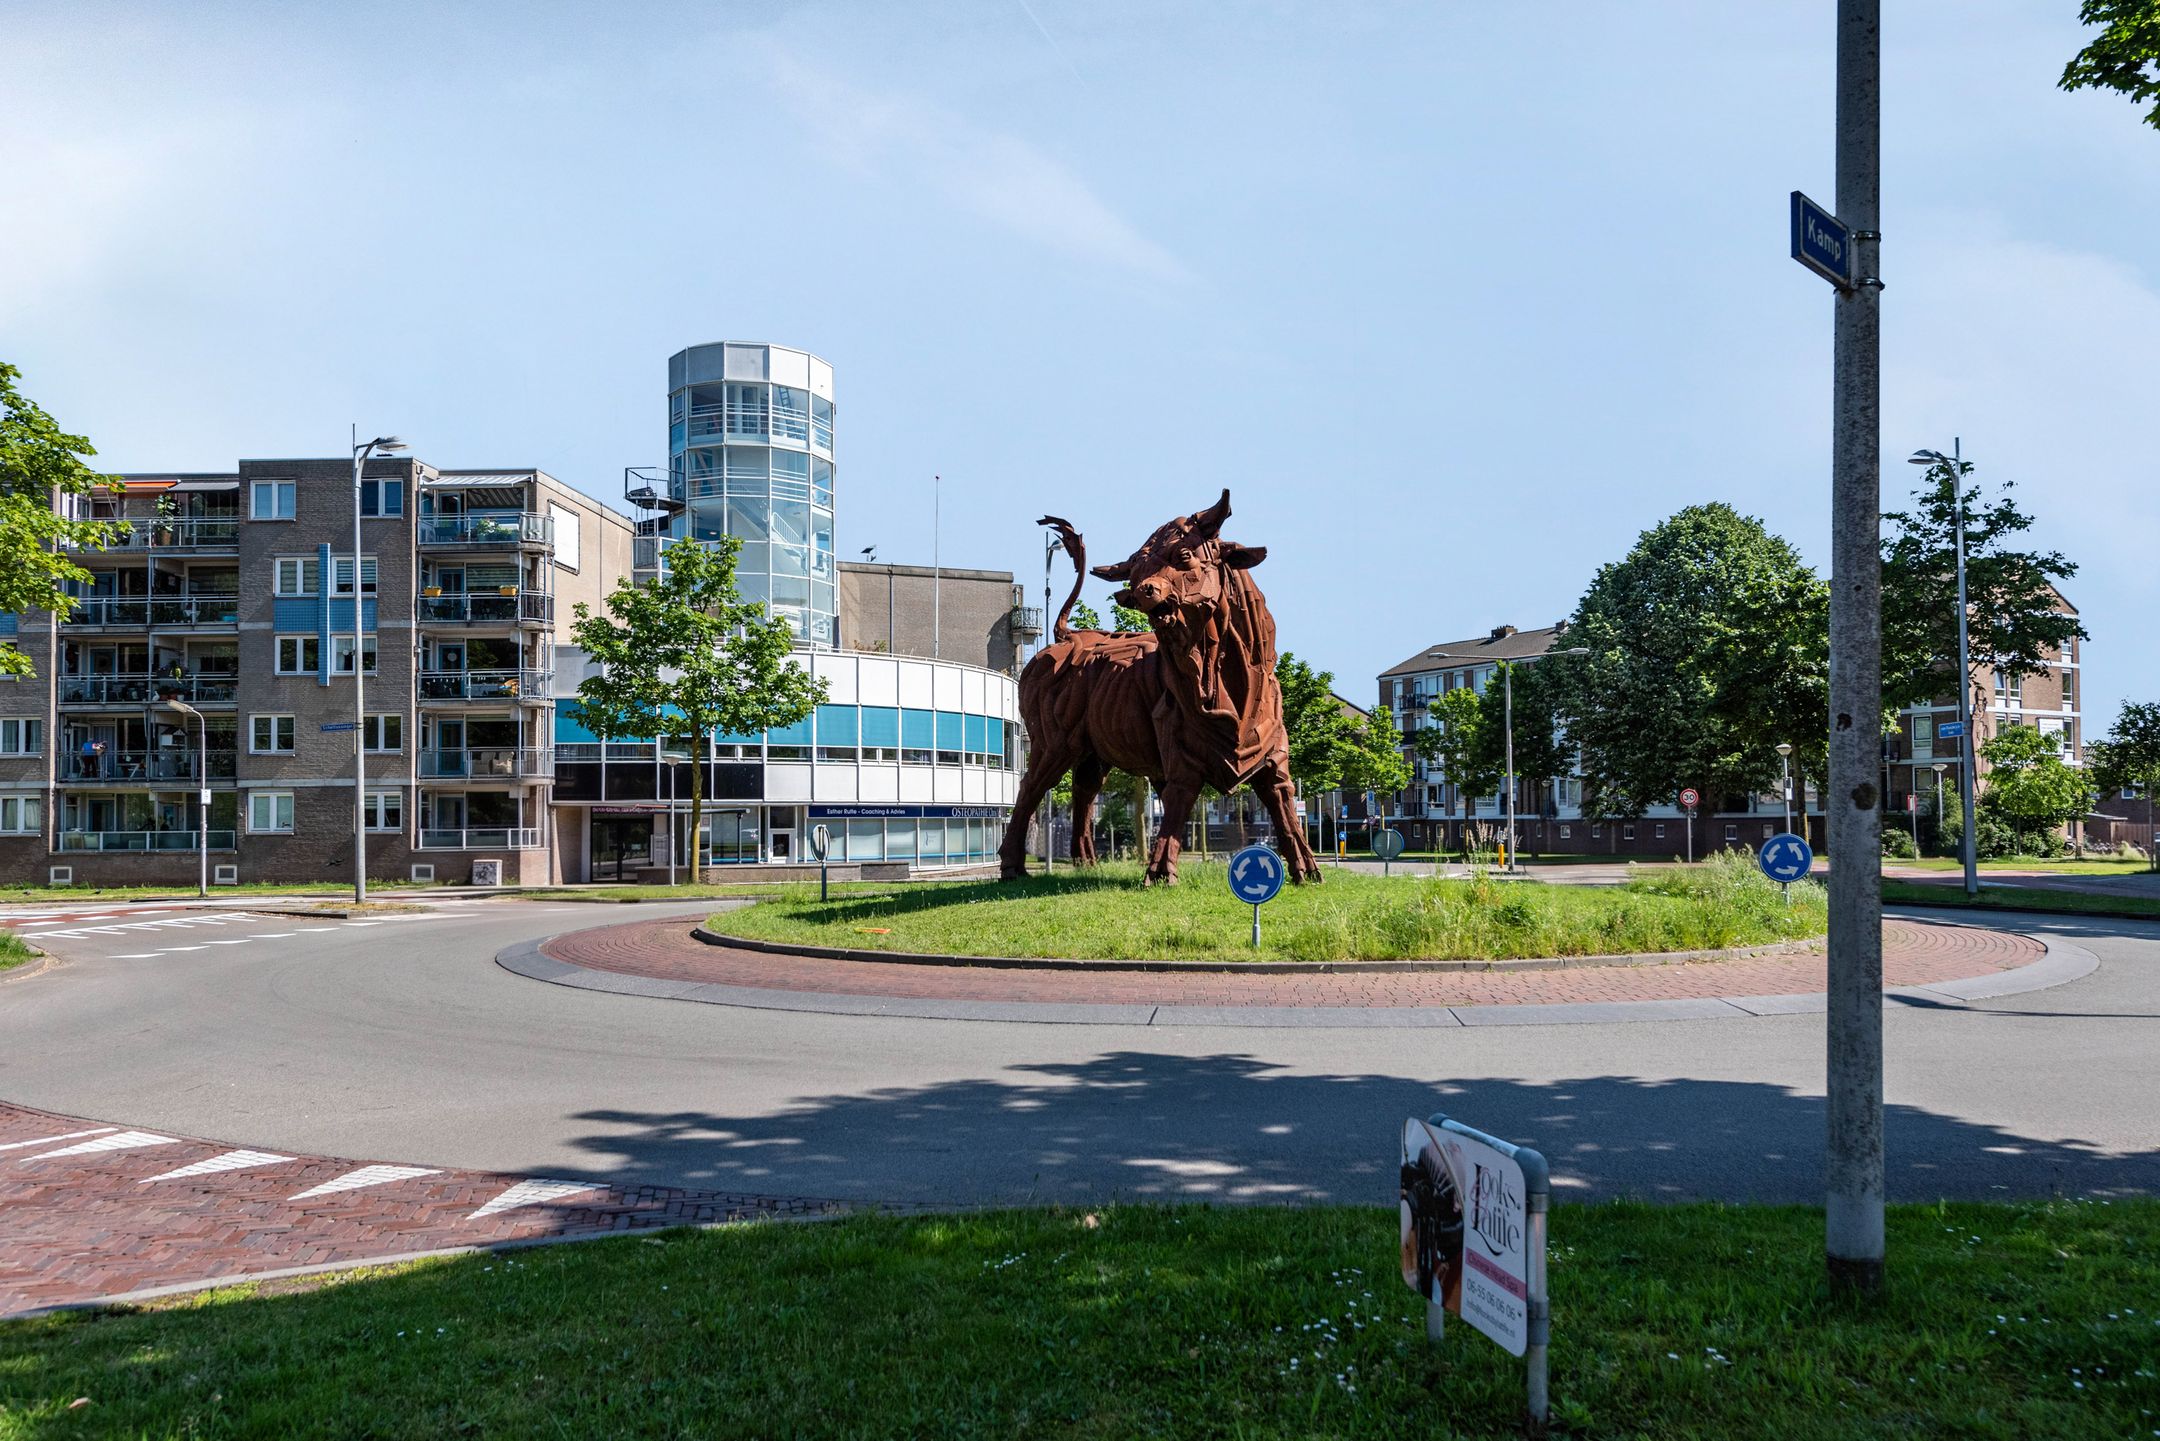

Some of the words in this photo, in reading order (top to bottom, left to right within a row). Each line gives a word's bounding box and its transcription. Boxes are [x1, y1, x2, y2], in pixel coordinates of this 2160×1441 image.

[1808, 215, 1841, 262] Kamp
[861, 808, 885, 816] Coaching
[951, 807, 988, 817] OSTEOPATHIE
[1486, 1291, 1496, 1307] 06
[1495, 1298, 1505, 1315] 06
[1505, 1304, 1516, 1321] 06
